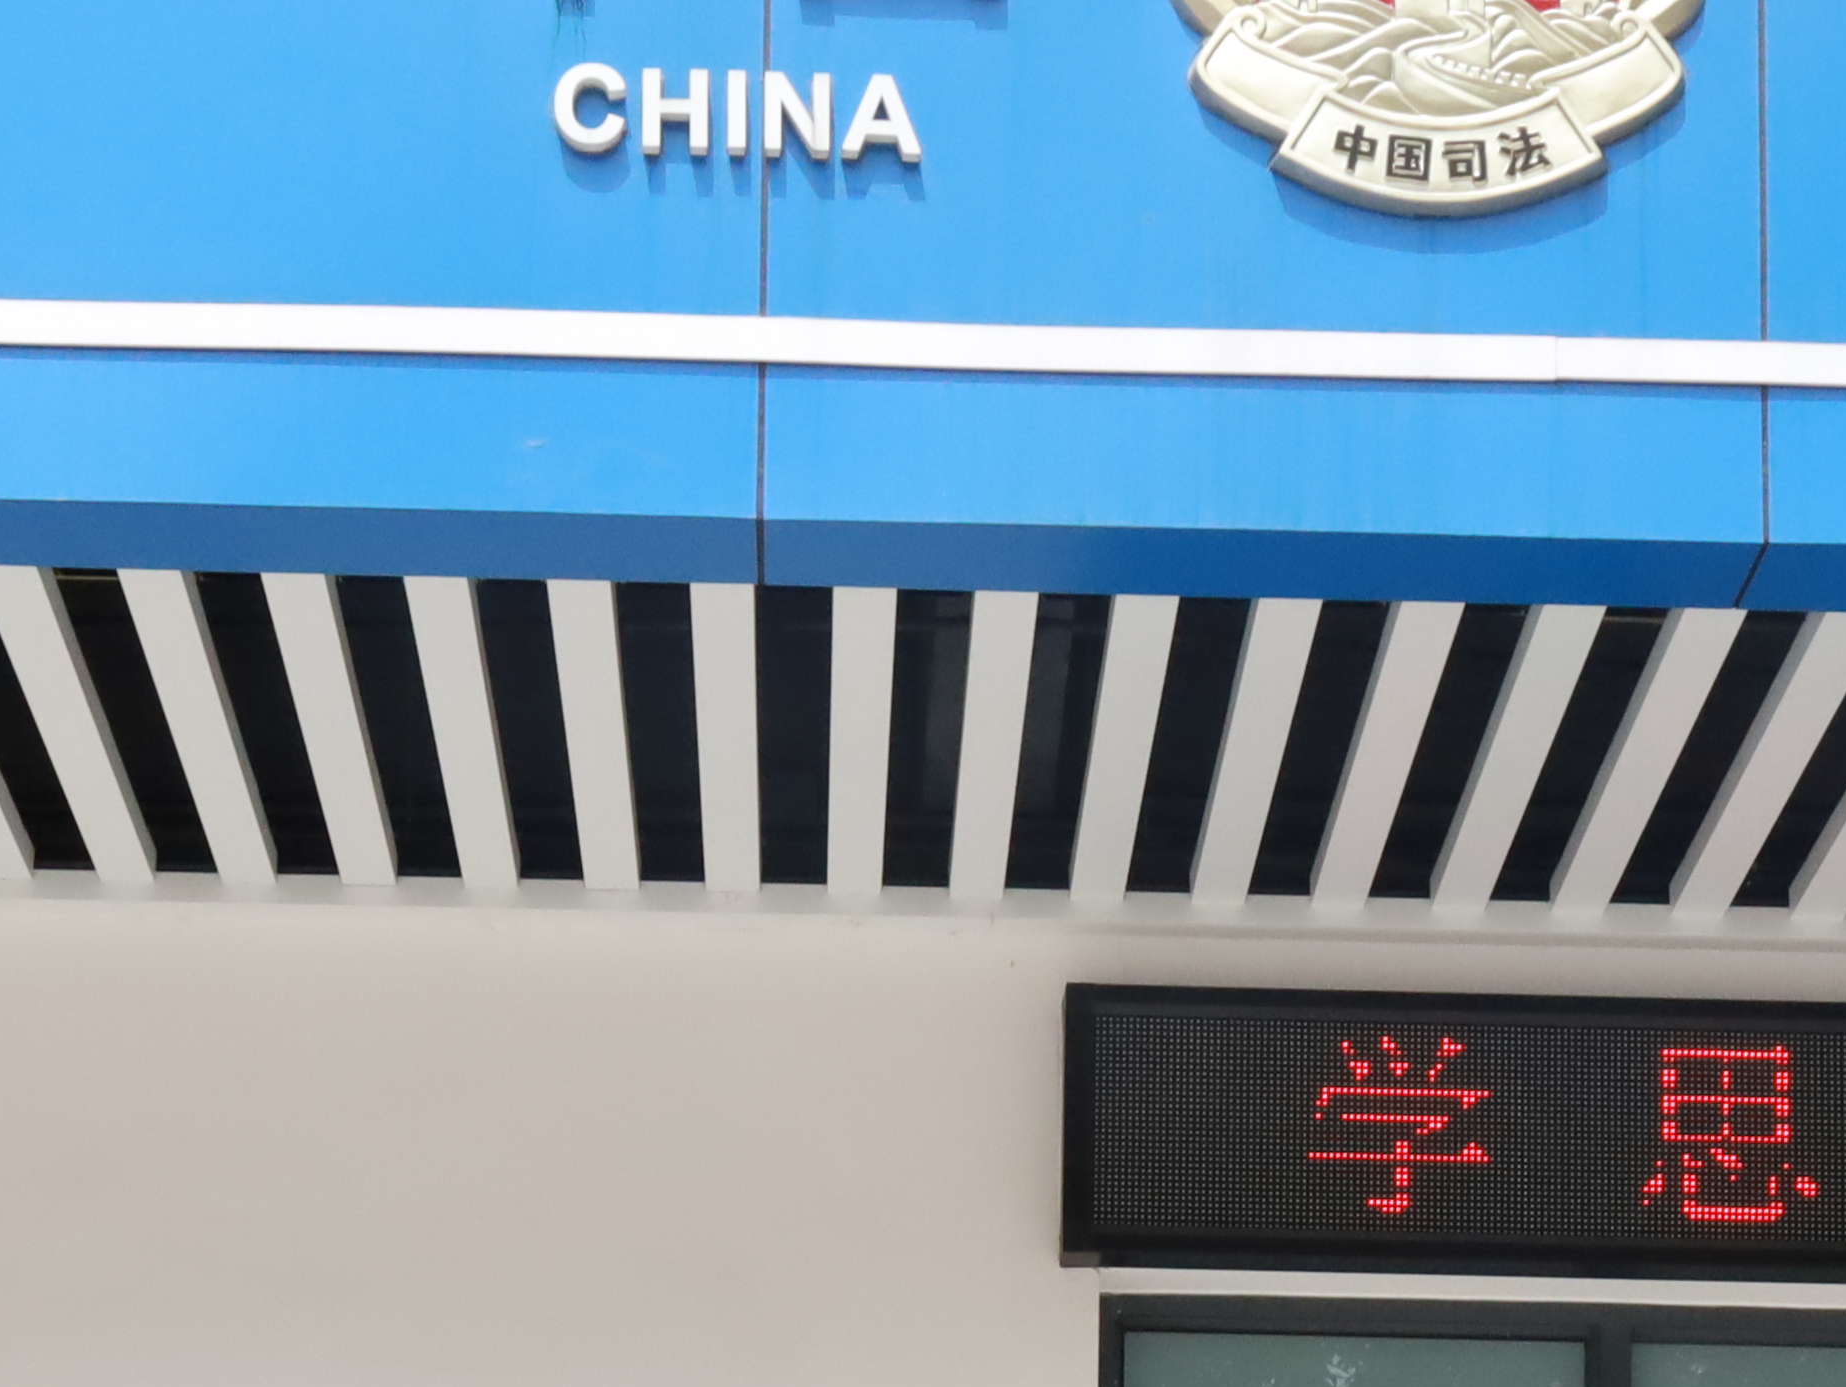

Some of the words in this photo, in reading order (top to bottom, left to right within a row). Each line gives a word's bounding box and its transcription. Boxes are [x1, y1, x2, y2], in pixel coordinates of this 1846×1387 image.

[554, 62, 922, 163] CHINA
[1333, 124, 1553, 184] 中国司法
